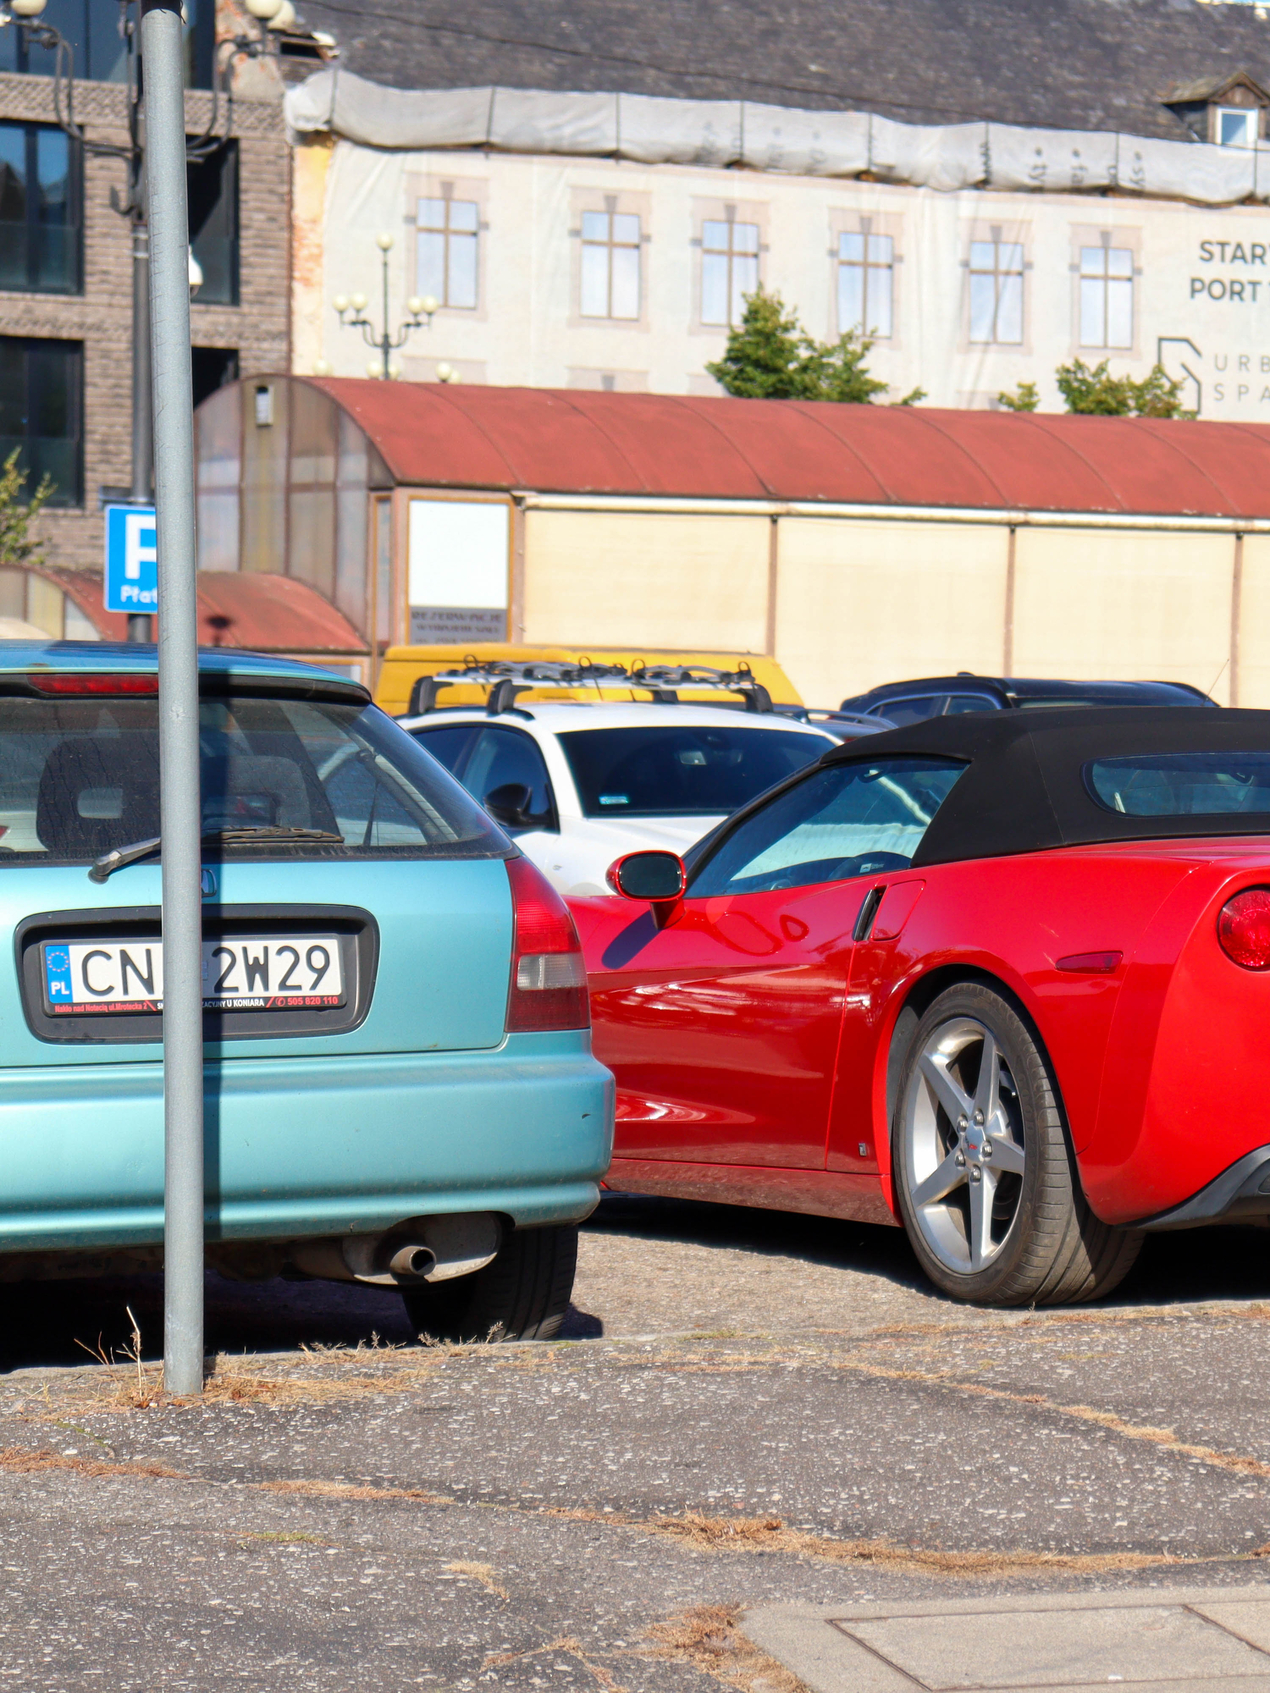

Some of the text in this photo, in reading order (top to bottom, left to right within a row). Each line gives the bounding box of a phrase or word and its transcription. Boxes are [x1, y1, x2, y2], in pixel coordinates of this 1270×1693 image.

[1190, 277, 1262, 302] PORT
[81, 945, 330, 997] CN 2W29
[51, 982, 70, 995] PL
[287, 997, 304, 1006] 505
[305, 997, 321, 1005] 820
[322, 996, 339, 1005] 110
